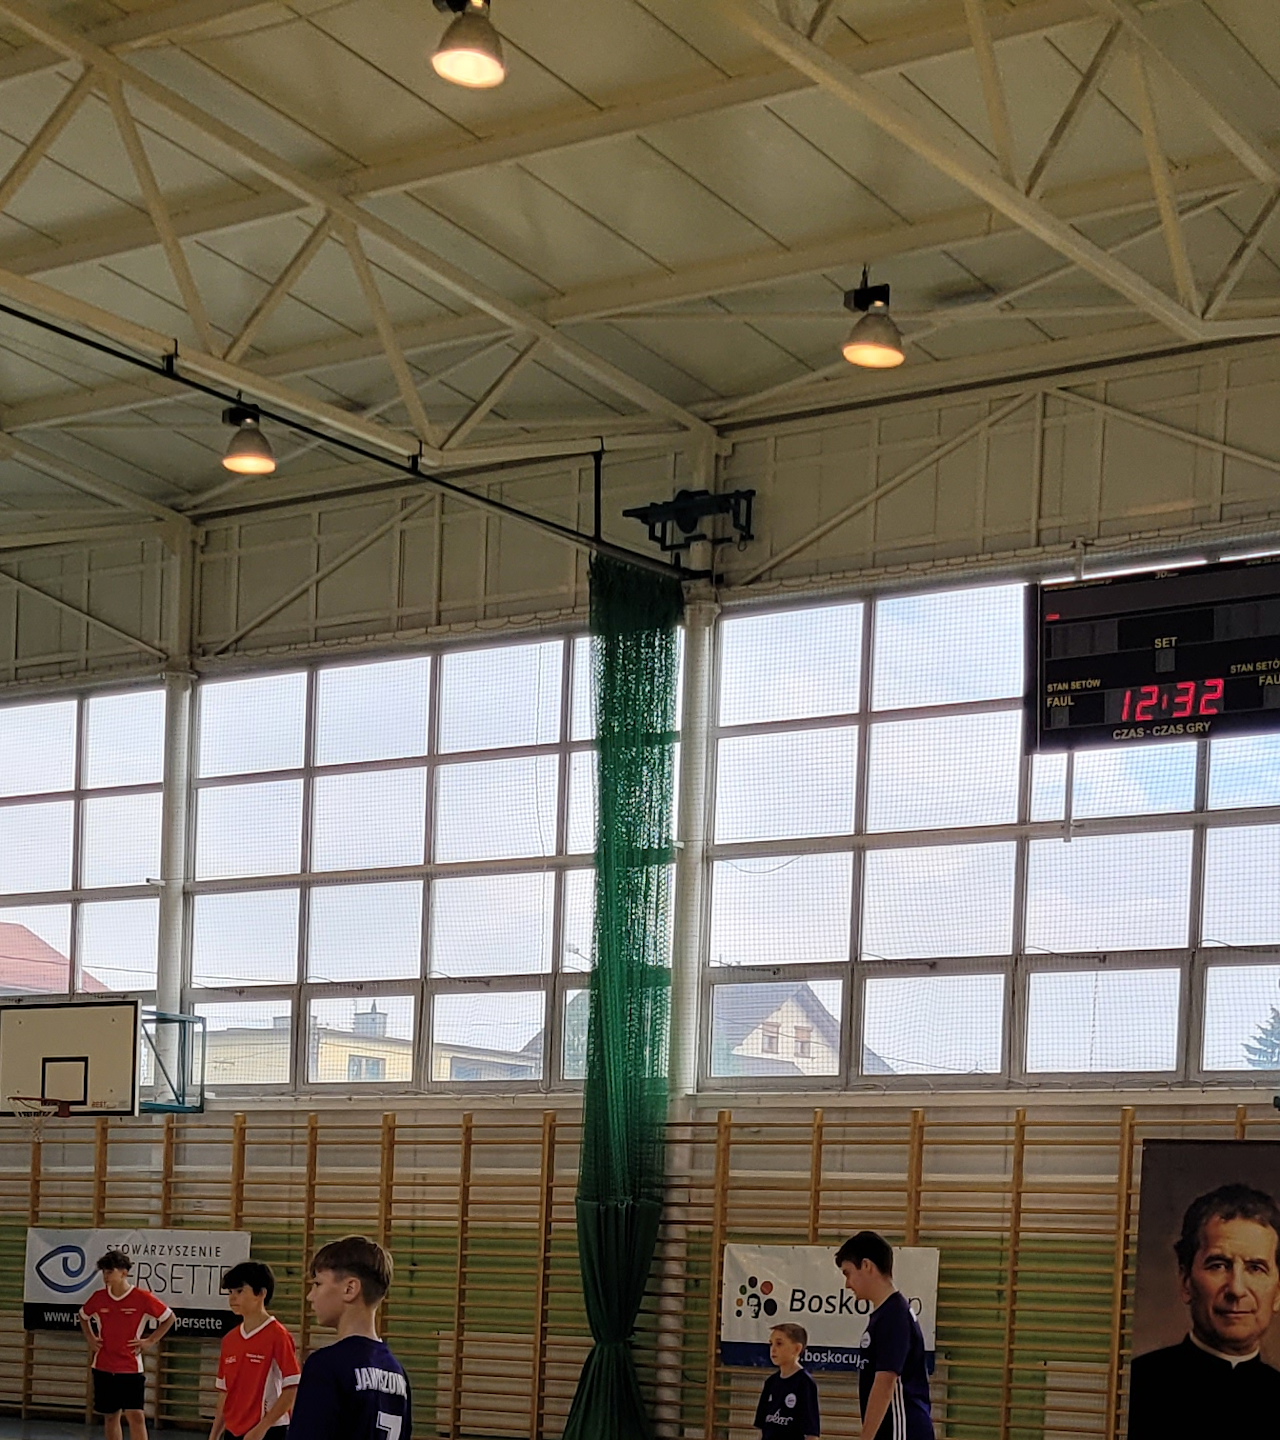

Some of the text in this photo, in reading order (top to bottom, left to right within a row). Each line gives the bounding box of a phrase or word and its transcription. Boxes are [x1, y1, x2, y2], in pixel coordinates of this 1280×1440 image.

[1154, 636, 1178, 649] SET
[1230, 663, 1253, 674] STAN
[1046, 678, 1101, 692] STAN SETÓW
[1046, 695, 1075, 707] FAUL
[1121, 678, 1225, 722] 12:32
[1112, 727, 1144, 740] CZAS
[1152, 724, 1184, 737] CZAS
[1186, 721, 1211, 734] GRY
[106, 1244, 222, 1258] SOWARZYSZENIE
[126, 1262, 233, 1296] RSETTE
[174, 1315, 223, 1332] persette
